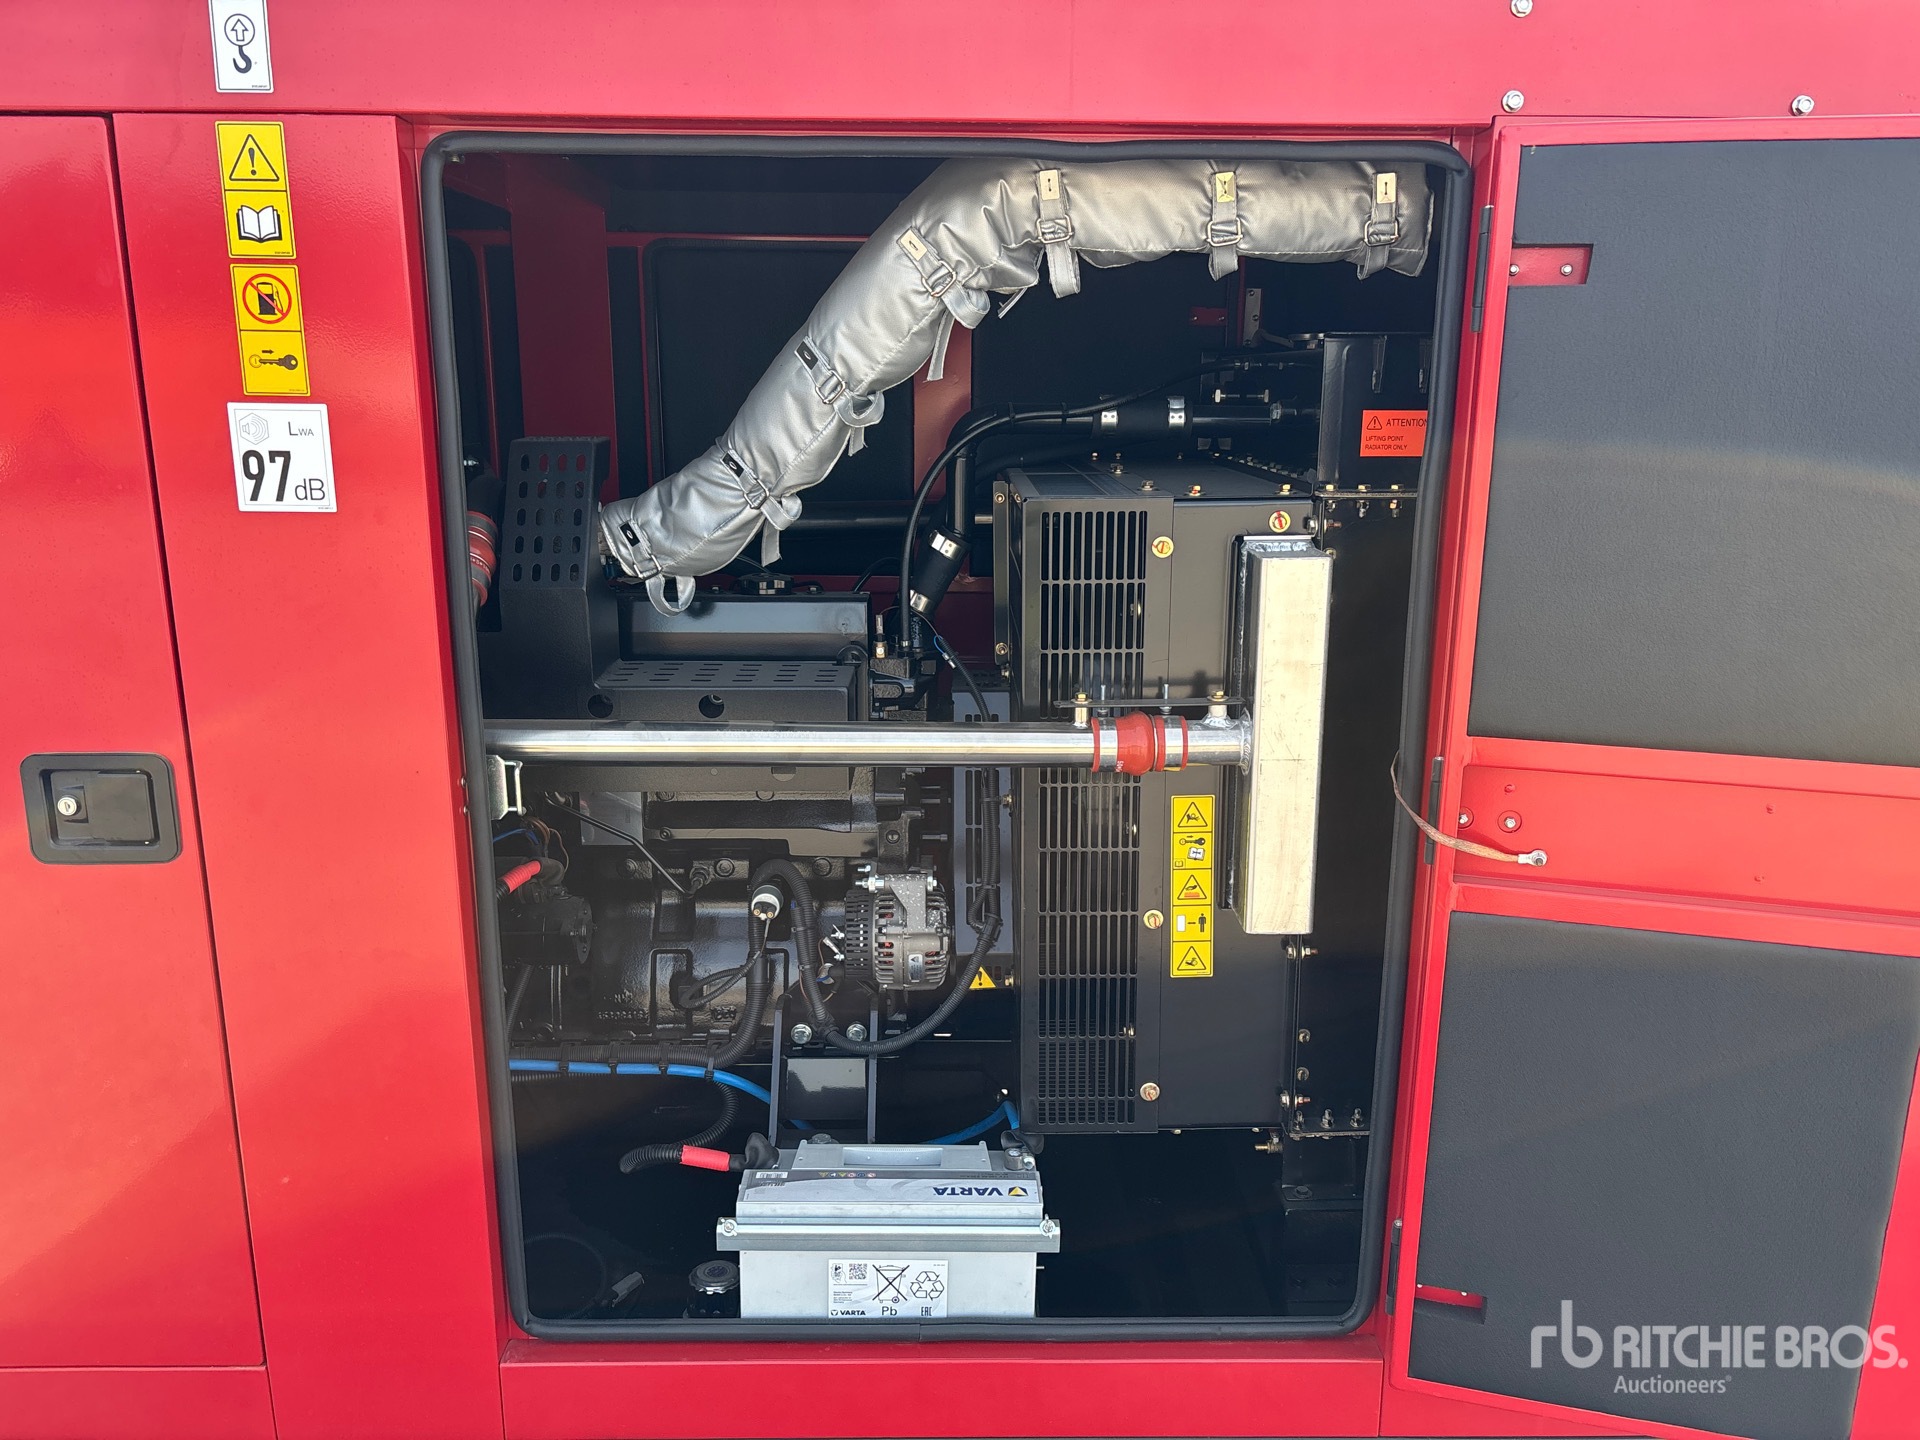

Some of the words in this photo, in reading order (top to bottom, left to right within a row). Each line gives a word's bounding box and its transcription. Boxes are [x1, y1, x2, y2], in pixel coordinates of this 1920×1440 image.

[242, 449, 291, 502] 97
[294, 477, 326, 501] dB
[933, 1186, 1004, 1196] VARTA
[881, 1305, 898, 1317] Pb
